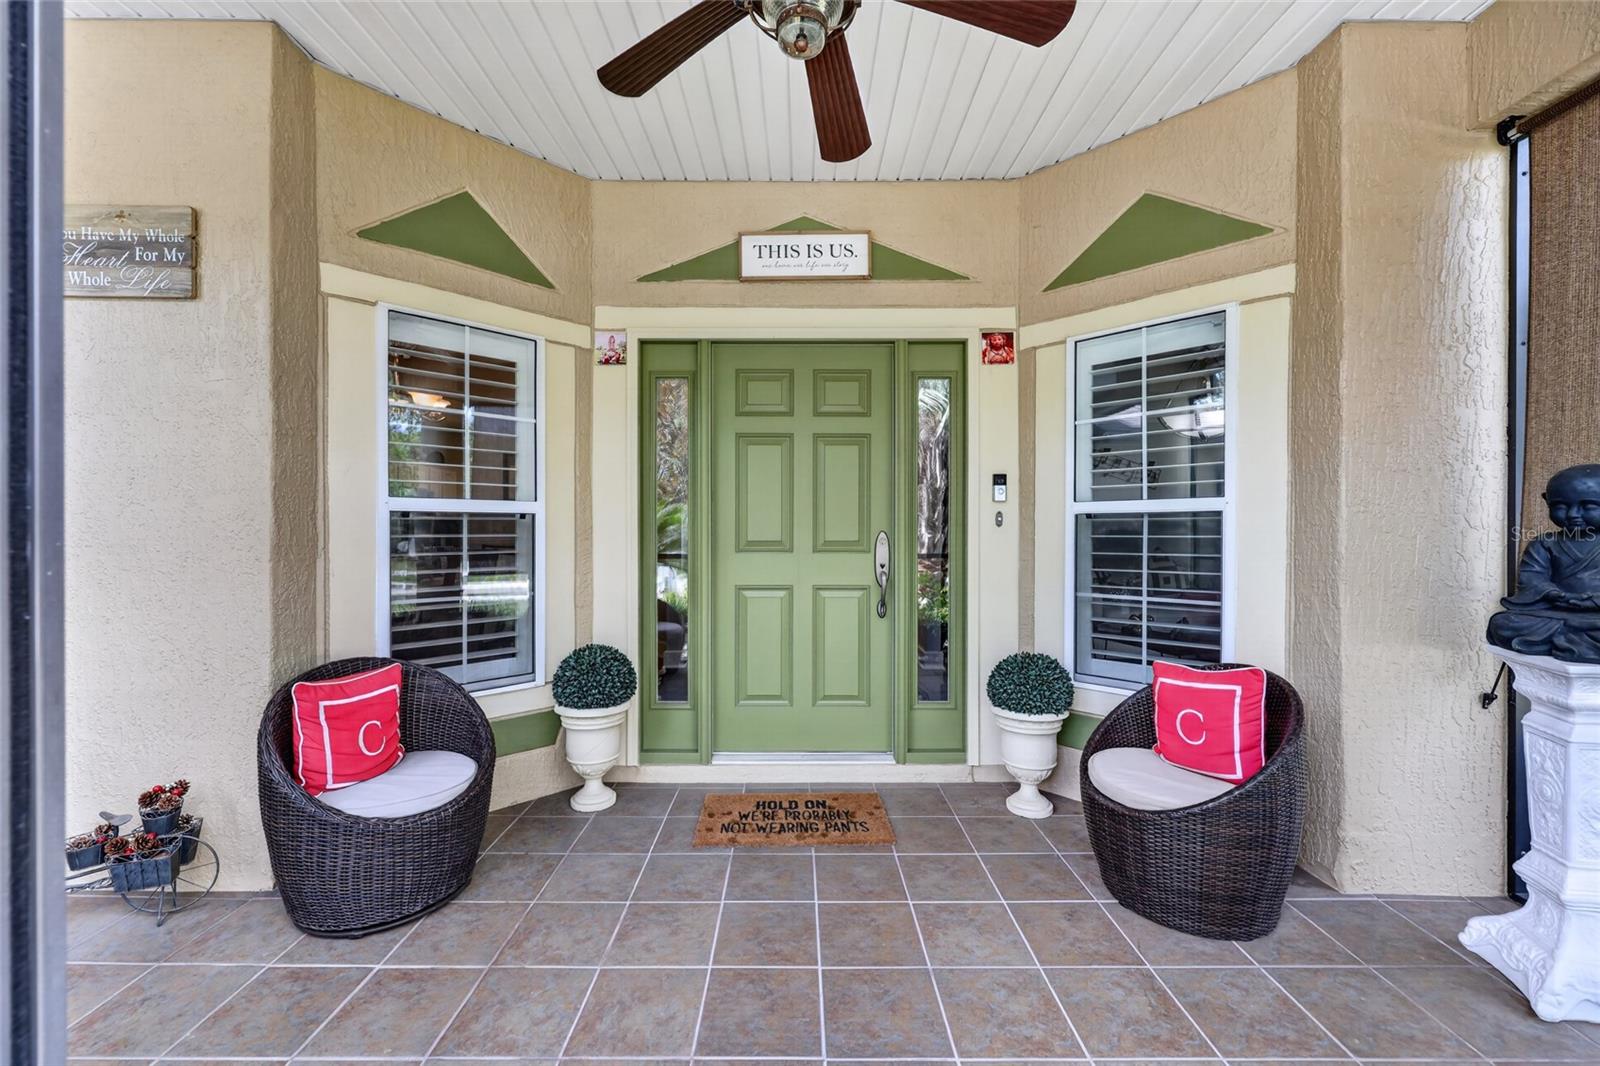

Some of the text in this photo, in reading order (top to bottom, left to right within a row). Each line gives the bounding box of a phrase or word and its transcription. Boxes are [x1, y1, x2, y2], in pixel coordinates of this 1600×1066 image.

[81, 226, 115, 241] Have
[119, 228, 139, 244] My
[145, 229, 185, 243] Whole
[63, 241, 185, 269] Heart For My
[753, 243, 858, 259] THIS IS US.
[68, 264, 172, 296] Whole Life
[1176, 709, 1206, 746] C
[358, 720, 386, 756] C
[755, 800, 799, 810] HOLD
[738, 811, 850, 821] WE'RE PROBABLY
[720, 820, 870, 835] NOT WEARING PANTS
